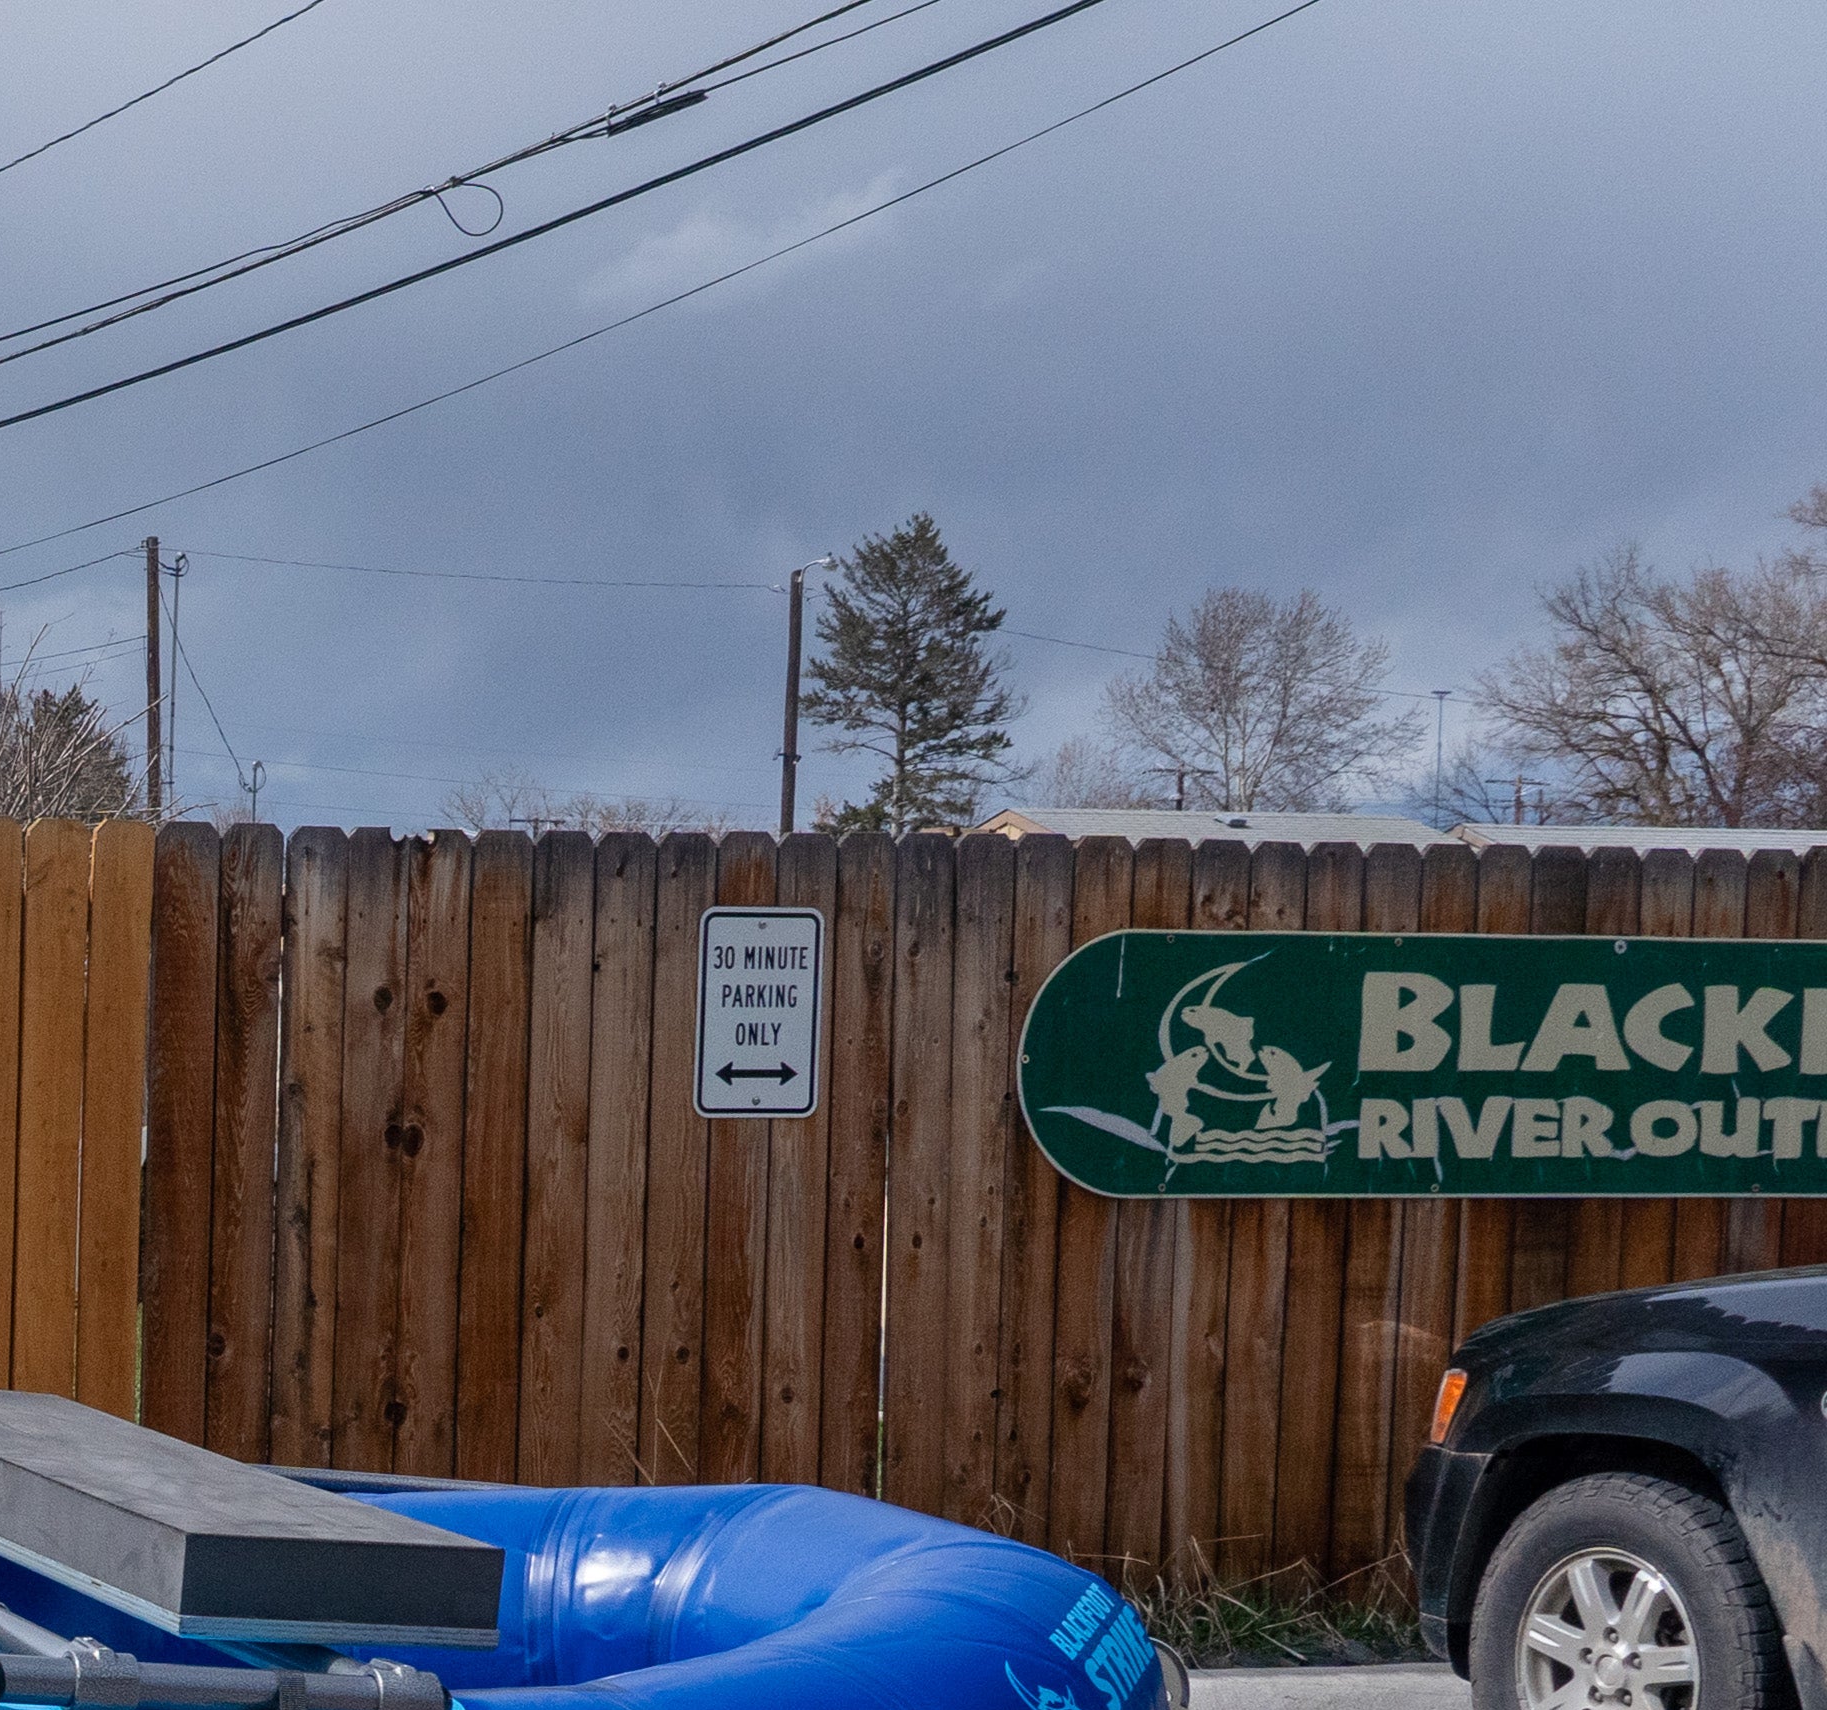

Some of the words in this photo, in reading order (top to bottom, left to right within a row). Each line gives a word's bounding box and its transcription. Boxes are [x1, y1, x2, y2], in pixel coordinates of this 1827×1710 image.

[713, 945, 736, 971] 30
[743, 945, 809, 971] MINUTE
[721, 984, 799, 1009] PARKING
[734, 1022, 783, 1047] ONLY
[1629, 1096, 1827, 1160] OUT
[1048, 1581, 1117, 1662] BLACKFOOT
